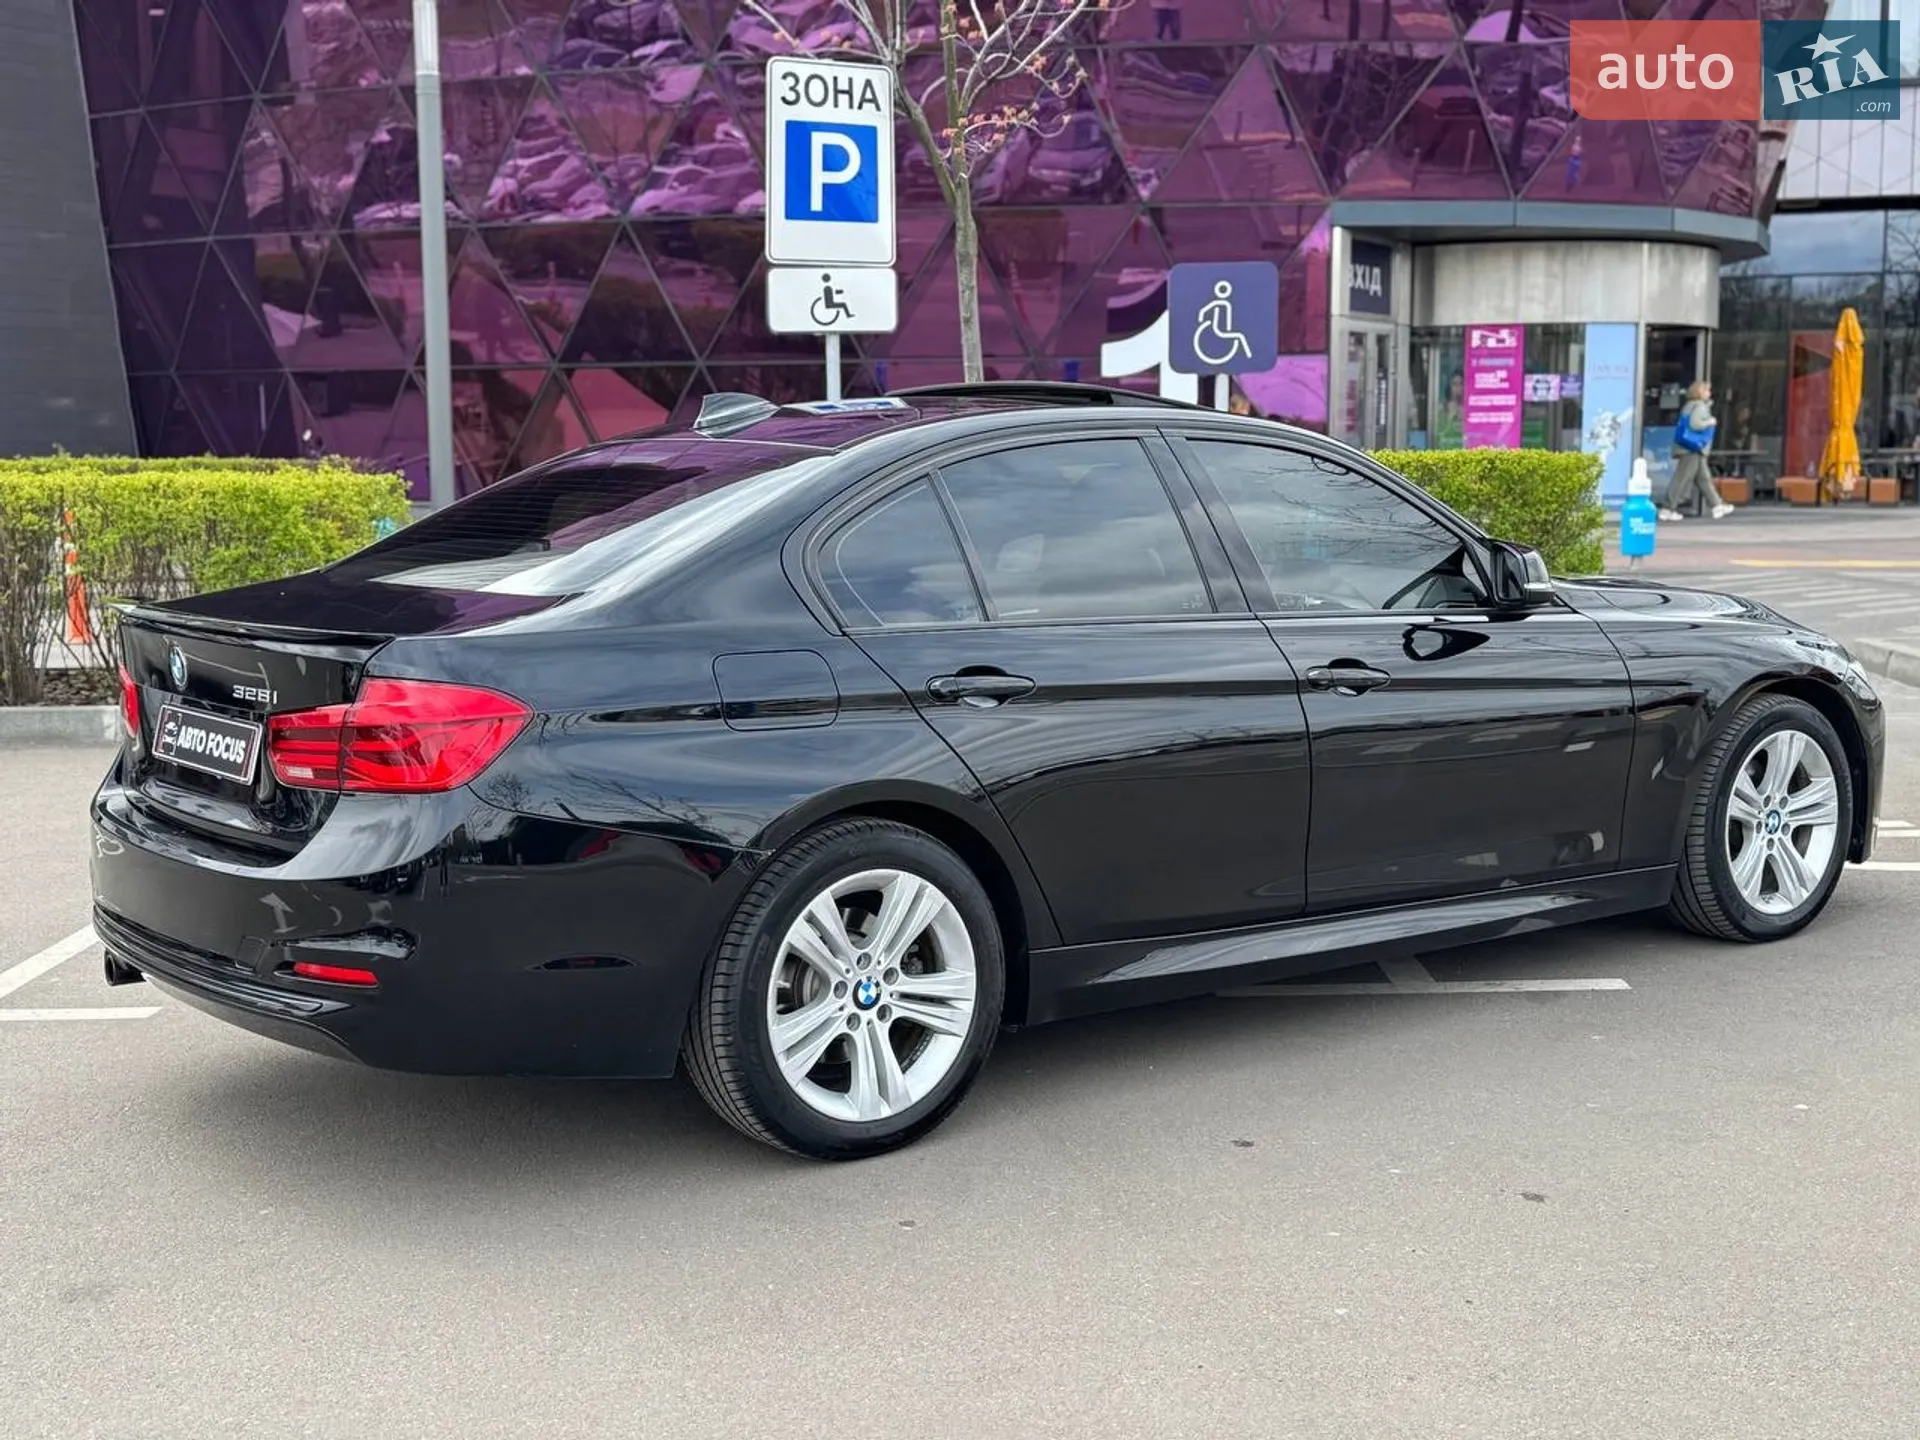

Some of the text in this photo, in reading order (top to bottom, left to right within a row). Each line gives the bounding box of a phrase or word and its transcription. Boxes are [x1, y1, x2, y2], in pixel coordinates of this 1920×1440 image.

[780, 71, 882, 112] ЗОНА
[810, 131, 861, 212] P
[205, 732, 246, 764] FOCUS
